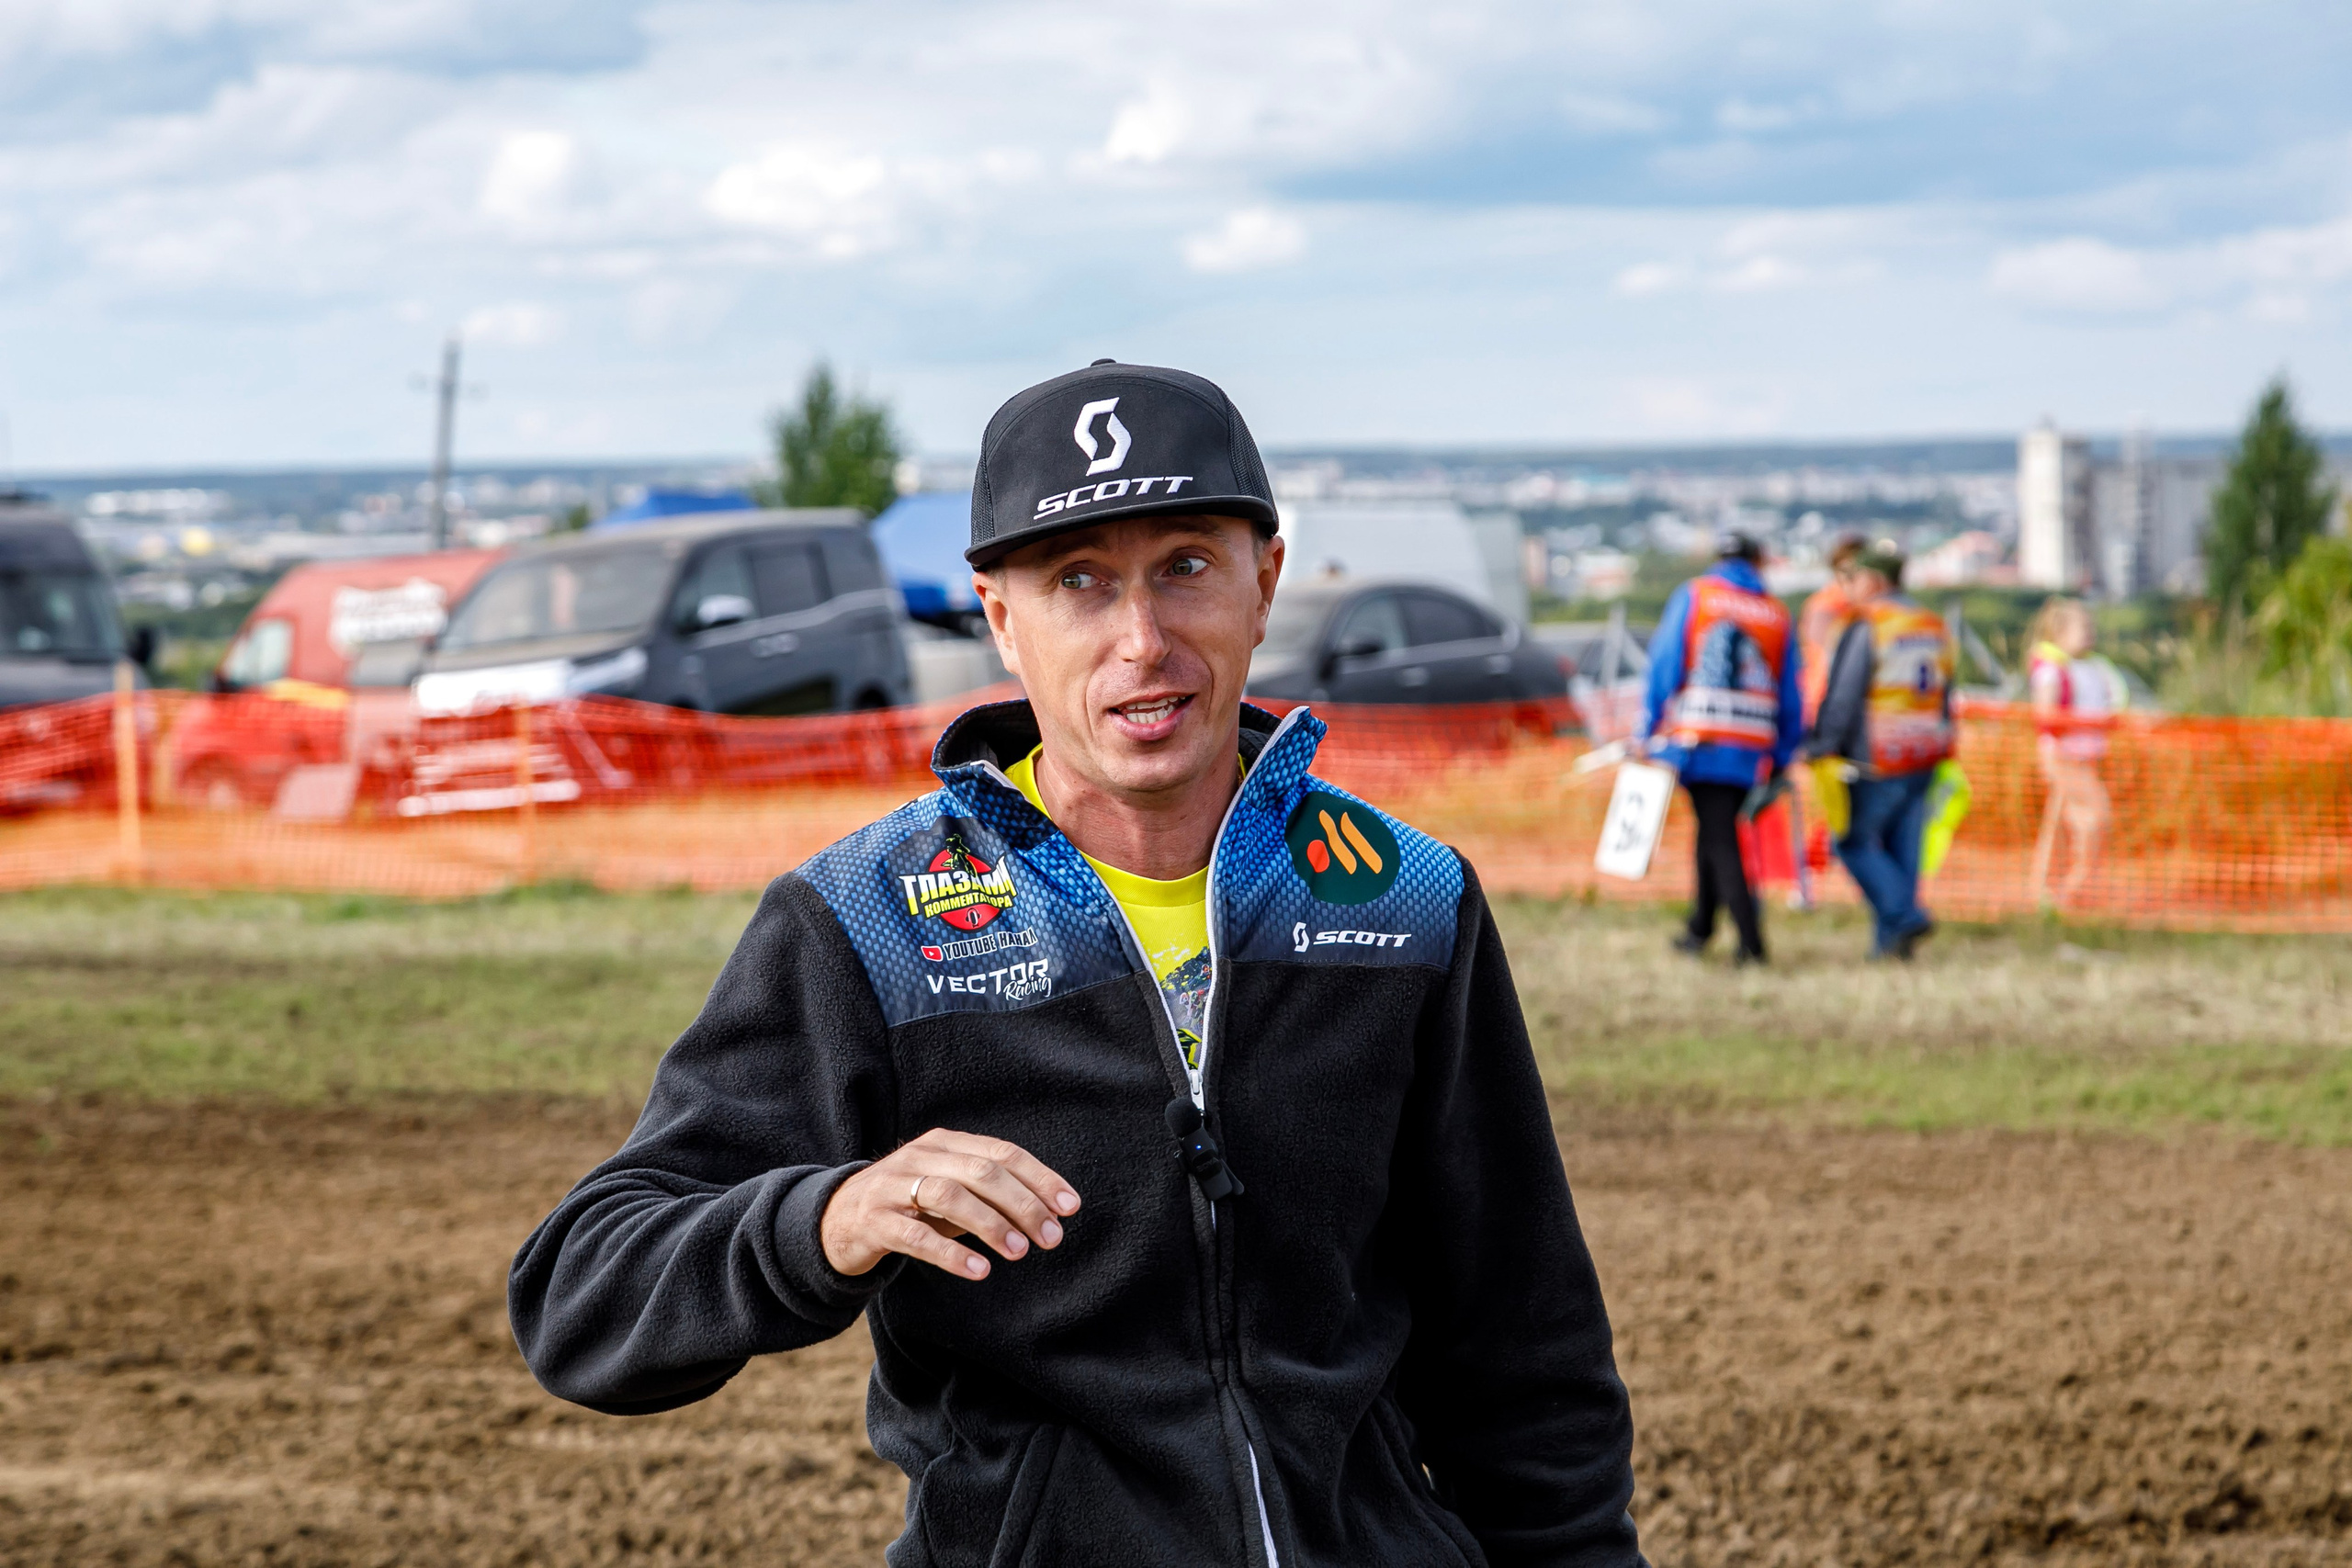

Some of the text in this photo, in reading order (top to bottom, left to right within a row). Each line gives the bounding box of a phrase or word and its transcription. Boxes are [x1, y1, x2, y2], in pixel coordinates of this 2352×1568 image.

[1034, 476, 1193, 520] SCOTT
[899, 855, 1017, 916] ГЛАЗАМИ
[924, 892, 1013, 919] КОММЕНТАТОРА
[944, 934, 997, 961] YOUTUBE
[1313, 931, 1412, 947] SCOTT
[927, 958, 1049, 995] VECTOR
[1003, 976, 1052, 1001] Racing
